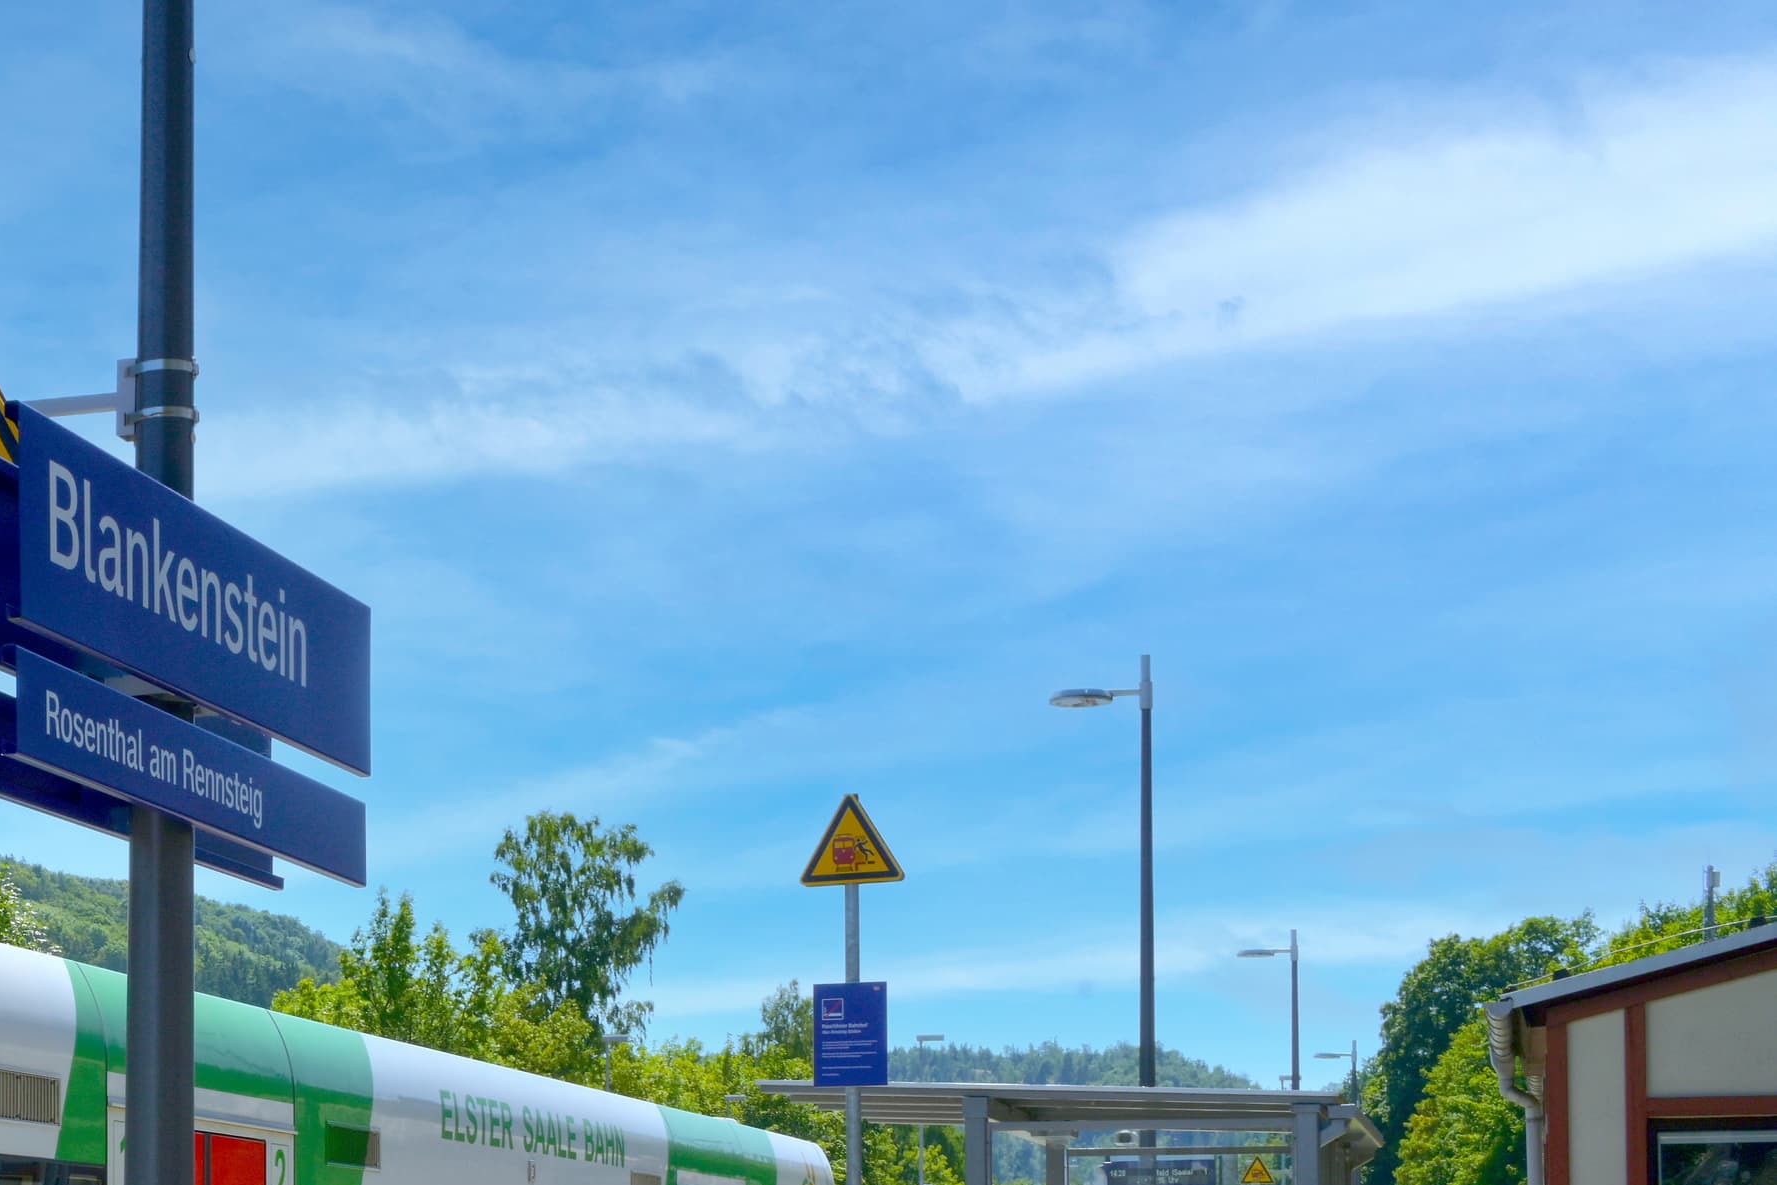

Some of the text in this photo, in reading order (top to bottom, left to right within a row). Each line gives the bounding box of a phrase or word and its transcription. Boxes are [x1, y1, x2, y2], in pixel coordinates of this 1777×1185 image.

[49, 459, 307, 688] Blankenstein
[45, 689, 263, 829] Rosenthal am Rennsteig
[439, 1089, 625, 1168] ELSTER SAALE BAHN
